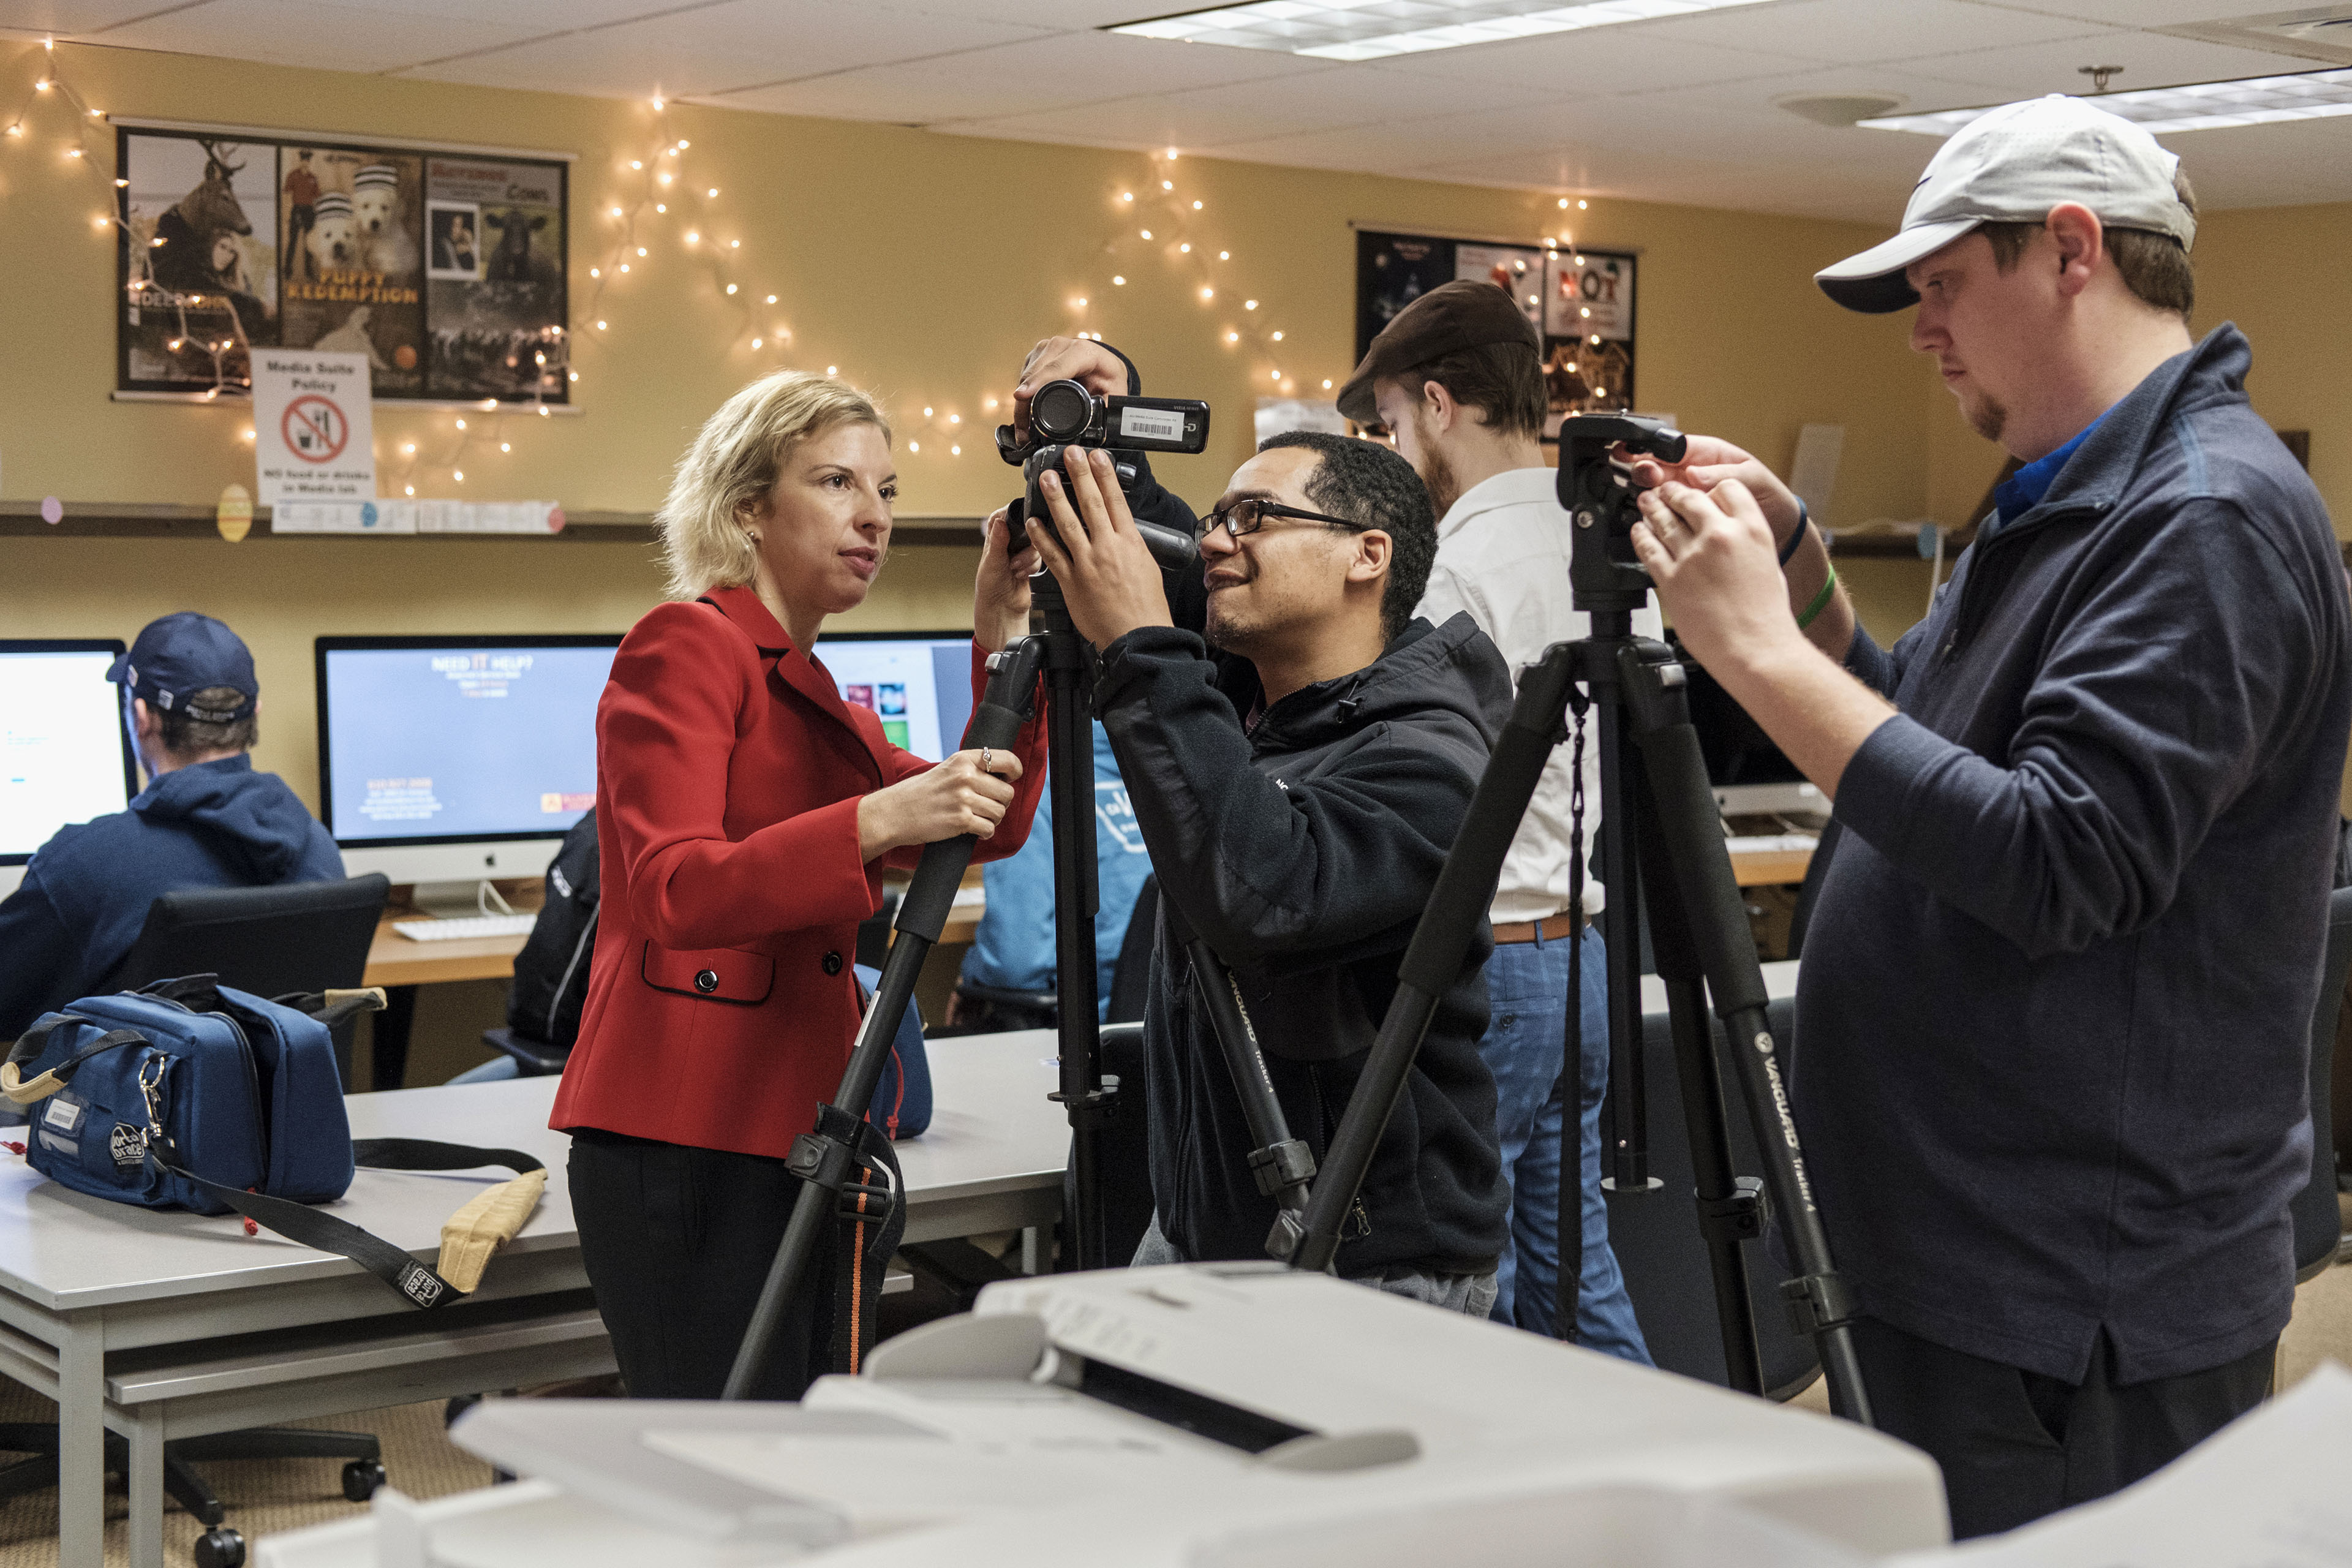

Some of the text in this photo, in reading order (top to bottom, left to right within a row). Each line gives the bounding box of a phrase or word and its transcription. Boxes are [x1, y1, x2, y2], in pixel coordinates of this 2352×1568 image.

[266, 361, 354, 375] Media Suite
[292, 378, 336, 393] Policy
[431, 656, 470, 671] NEED
[491, 655, 533, 671] HELP?
[1227, 970, 1257, 1042] VANGUARD
[1255, 1050, 1270, 1085] Tracker
[1764, 1056, 1800, 1148] VANGUARD
[113, 1144, 142, 1158] brace
[407, 1271, 426, 1294] brace
